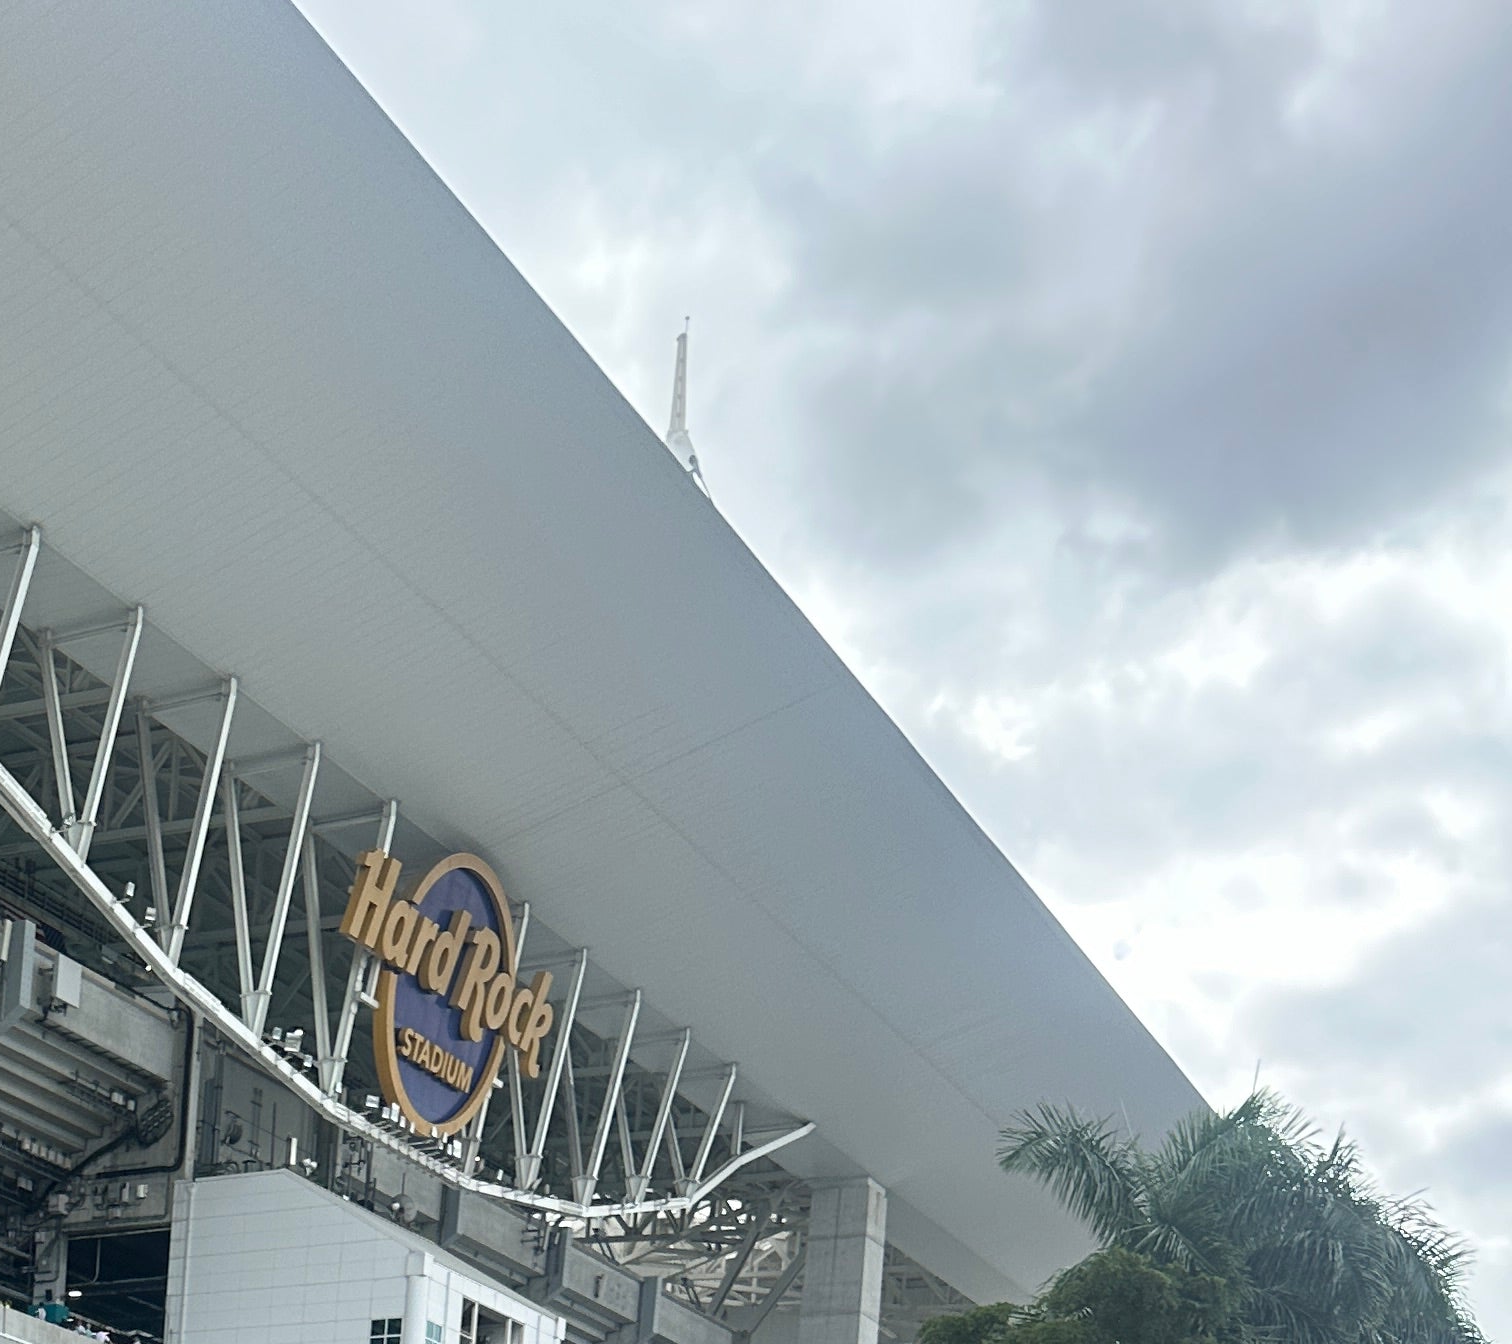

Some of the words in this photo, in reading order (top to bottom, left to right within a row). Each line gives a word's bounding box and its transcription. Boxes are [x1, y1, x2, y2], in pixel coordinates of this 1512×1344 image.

[339, 848, 474, 996] Hard
[448, 925, 554, 1079] Rock
[398, 1027, 474, 1094] STADIUM
